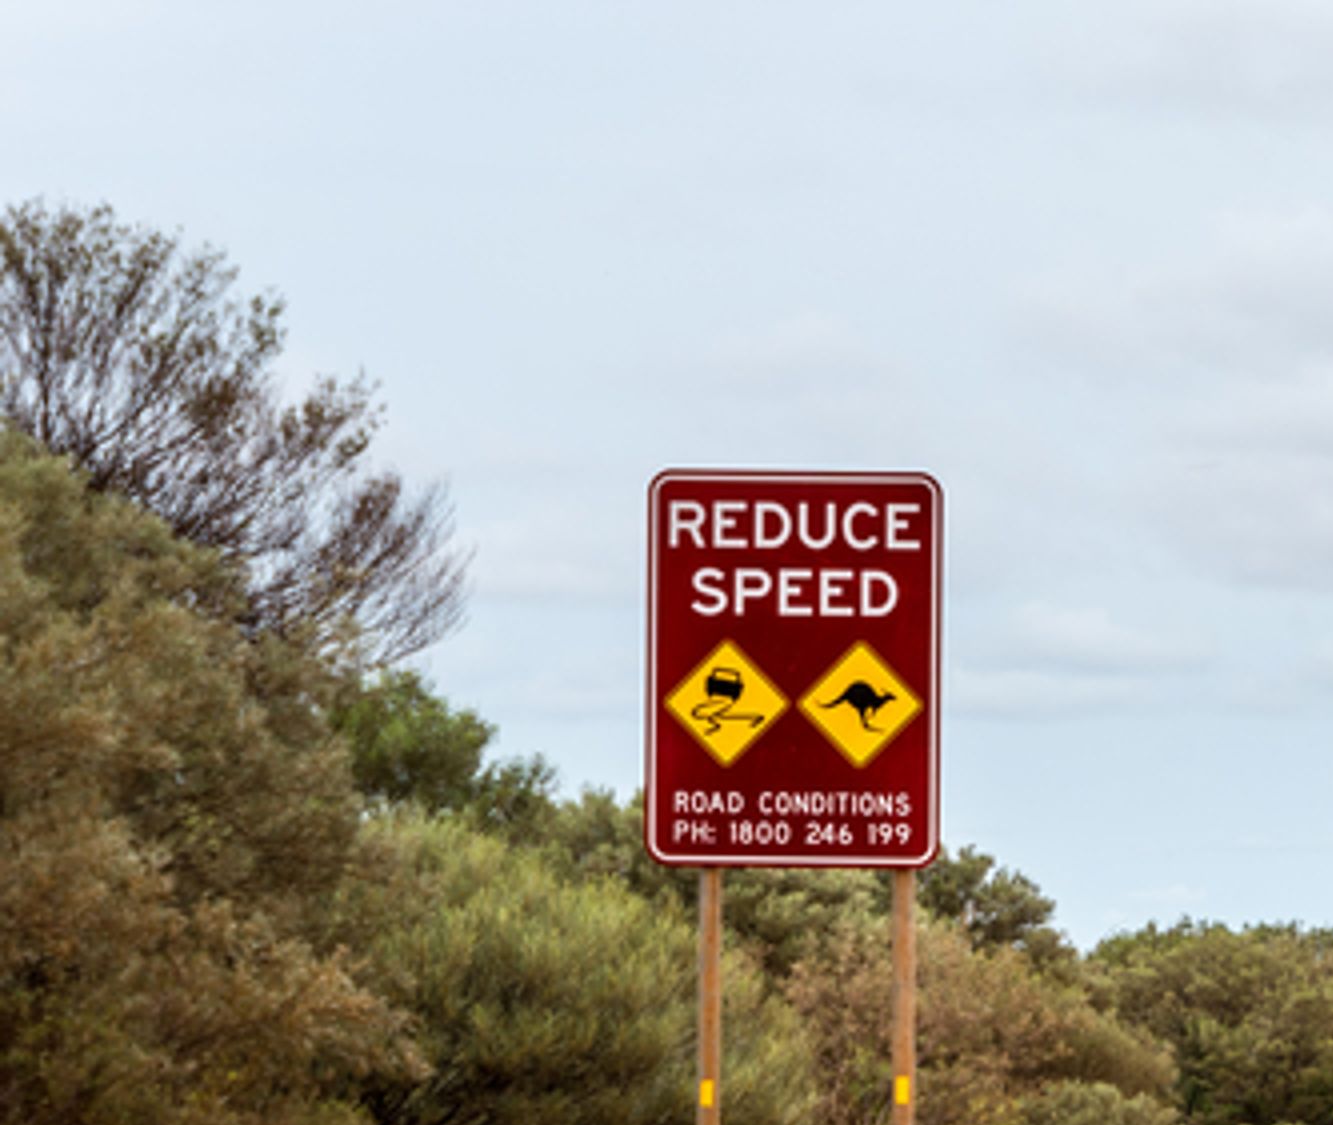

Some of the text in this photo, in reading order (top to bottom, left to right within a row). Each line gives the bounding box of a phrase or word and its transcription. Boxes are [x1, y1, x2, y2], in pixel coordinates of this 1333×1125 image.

[668, 500, 921, 550] REDUCE
[691, 567, 898, 617] SPEED
[673, 791, 911, 816] ROAD CONDITIONS
[673, 819, 911, 845] PH: 1800 246 199
